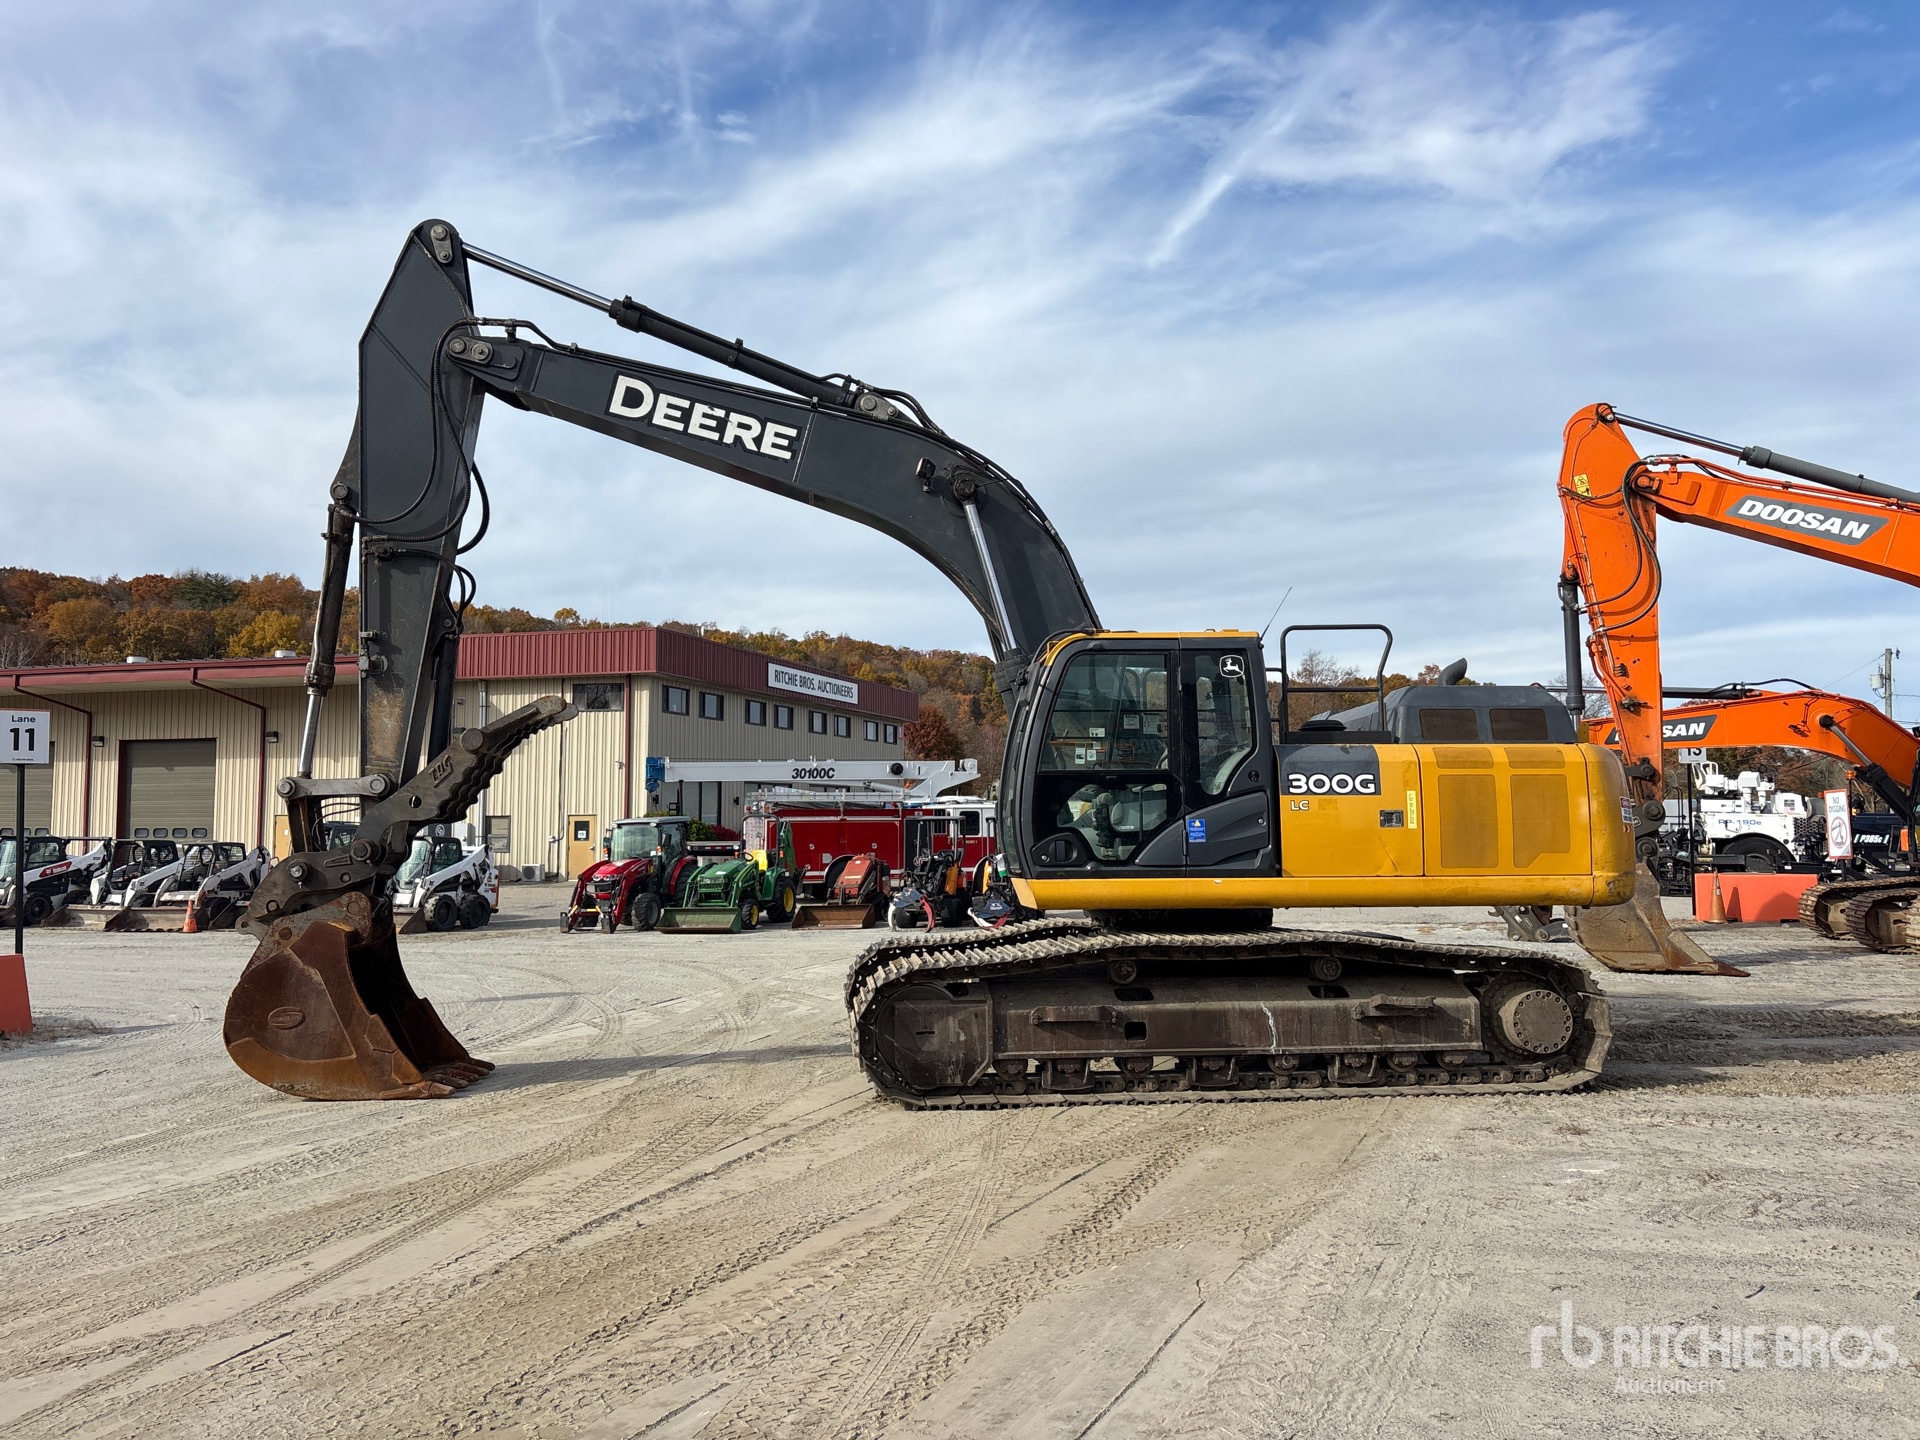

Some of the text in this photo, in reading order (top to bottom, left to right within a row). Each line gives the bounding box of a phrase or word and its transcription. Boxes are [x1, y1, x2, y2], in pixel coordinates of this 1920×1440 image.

[609, 375, 798, 460] DEERE
[1738, 500, 1870, 539] DOOSAN
[774, 669, 853, 699] RITCHIE BROS. AUCTIONEERS
[11, 714, 36, 723] Lane
[9, 727, 35, 751] 11
[791, 767, 836, 780] 30100C
[1288, 773, 1376, 794] 300G
[1290, 800, 1310, 811] LC
[1828, 804, 1846, 813] DIGGING
